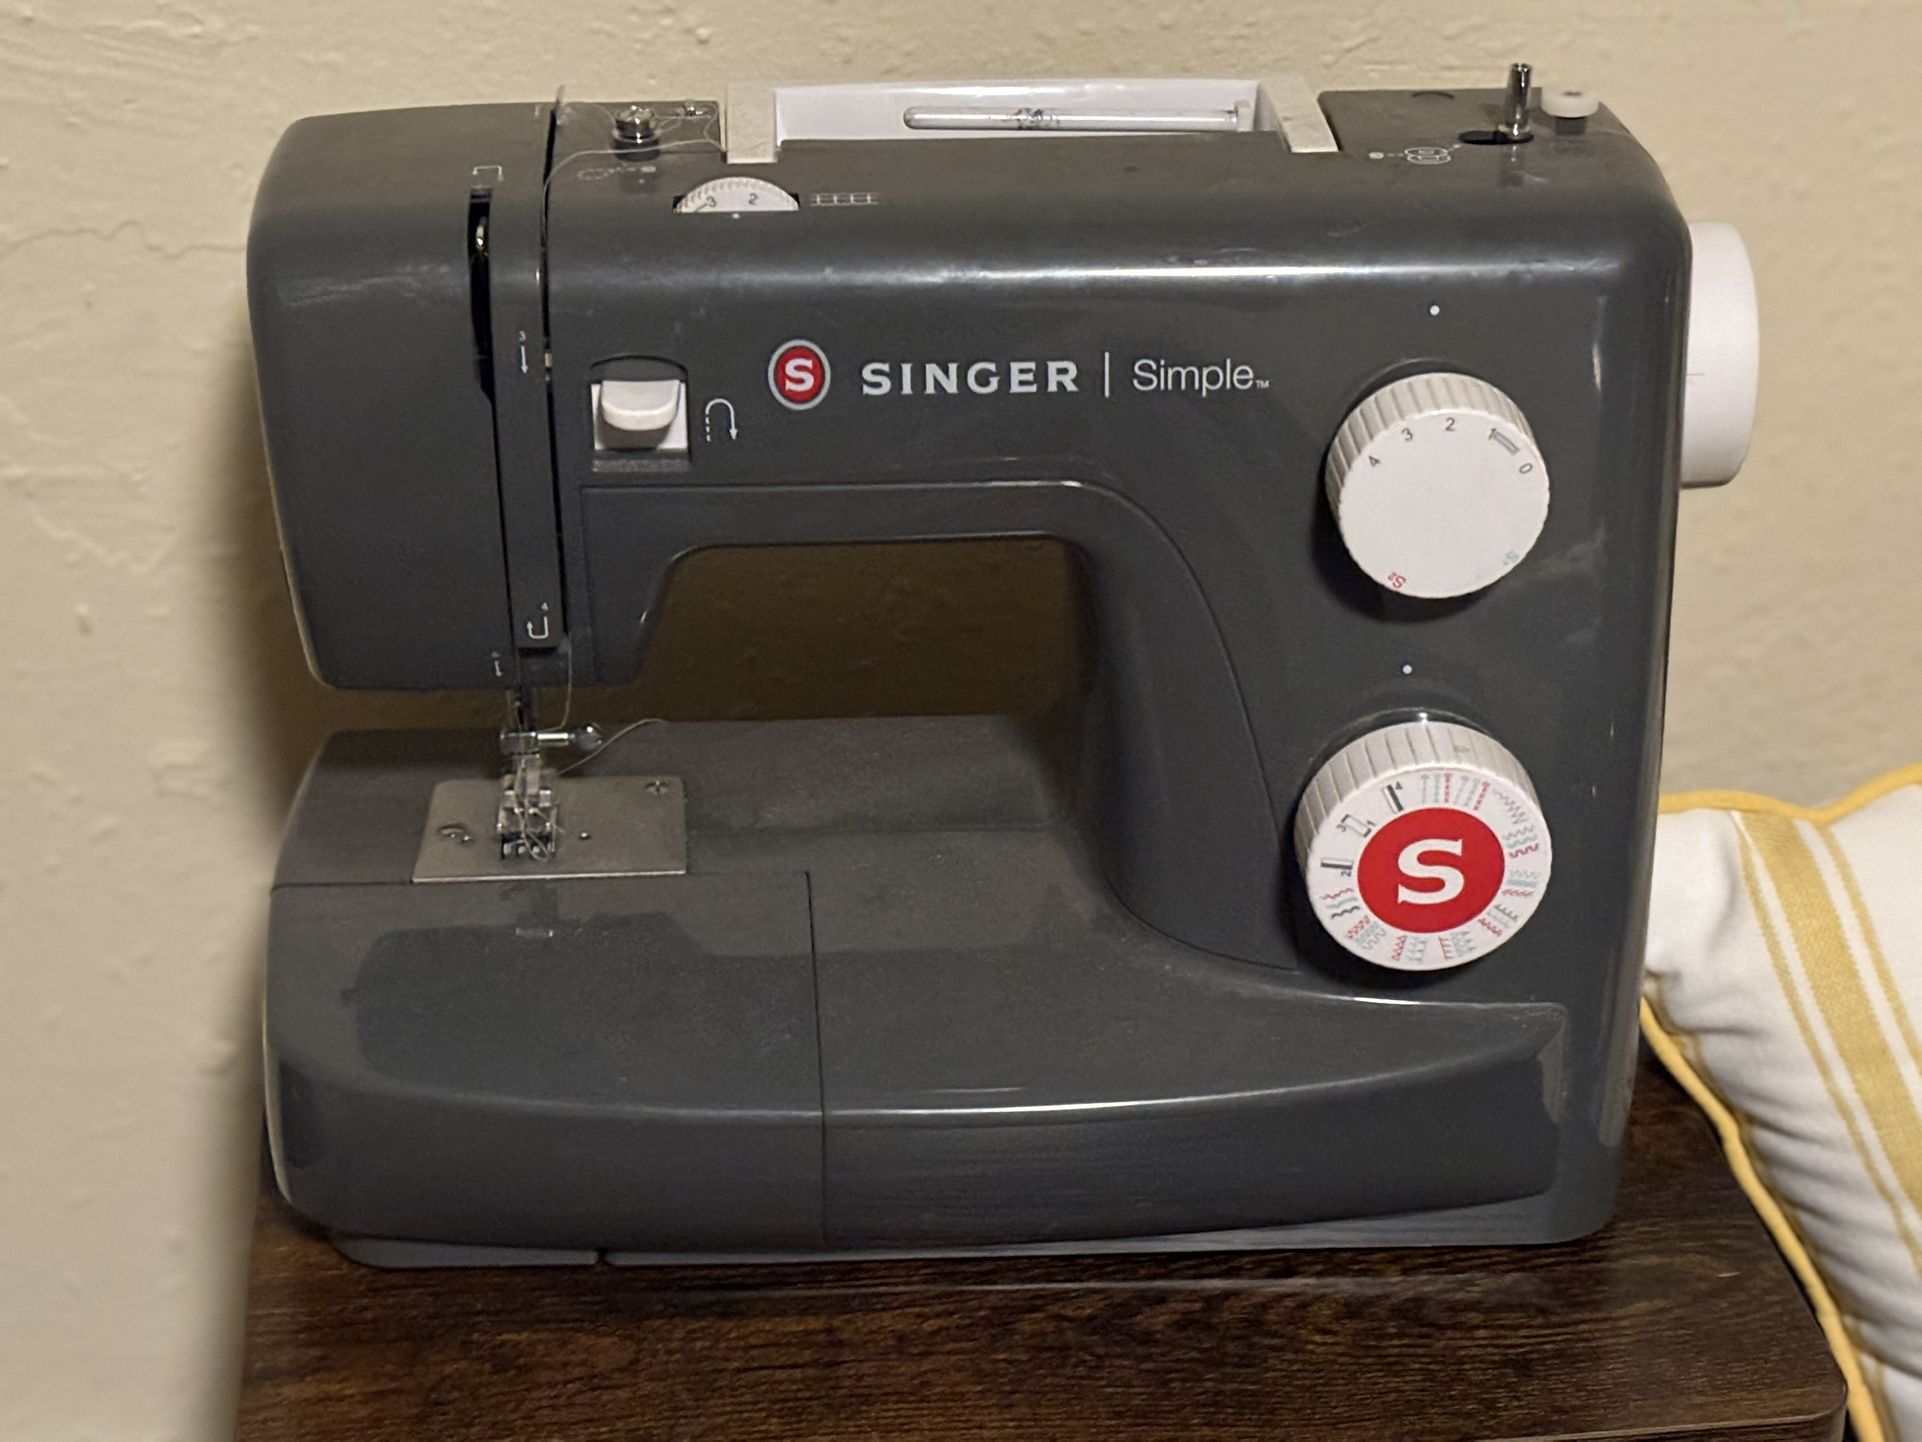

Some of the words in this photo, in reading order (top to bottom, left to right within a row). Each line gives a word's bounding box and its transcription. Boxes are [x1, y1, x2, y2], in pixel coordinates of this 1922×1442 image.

[706, 196, 717, 208] 3
[748, 192, 759, 206] 2
[861, 360, 1080, 397] SINGER
[1444, 417, 1456, 432] 2
[1402, 427, 1414, 442] 3
[1367, 454, 1381, 468] 4
[1518, 462, 1534, 475] 0
[1397, 837, 1466, 905] S
